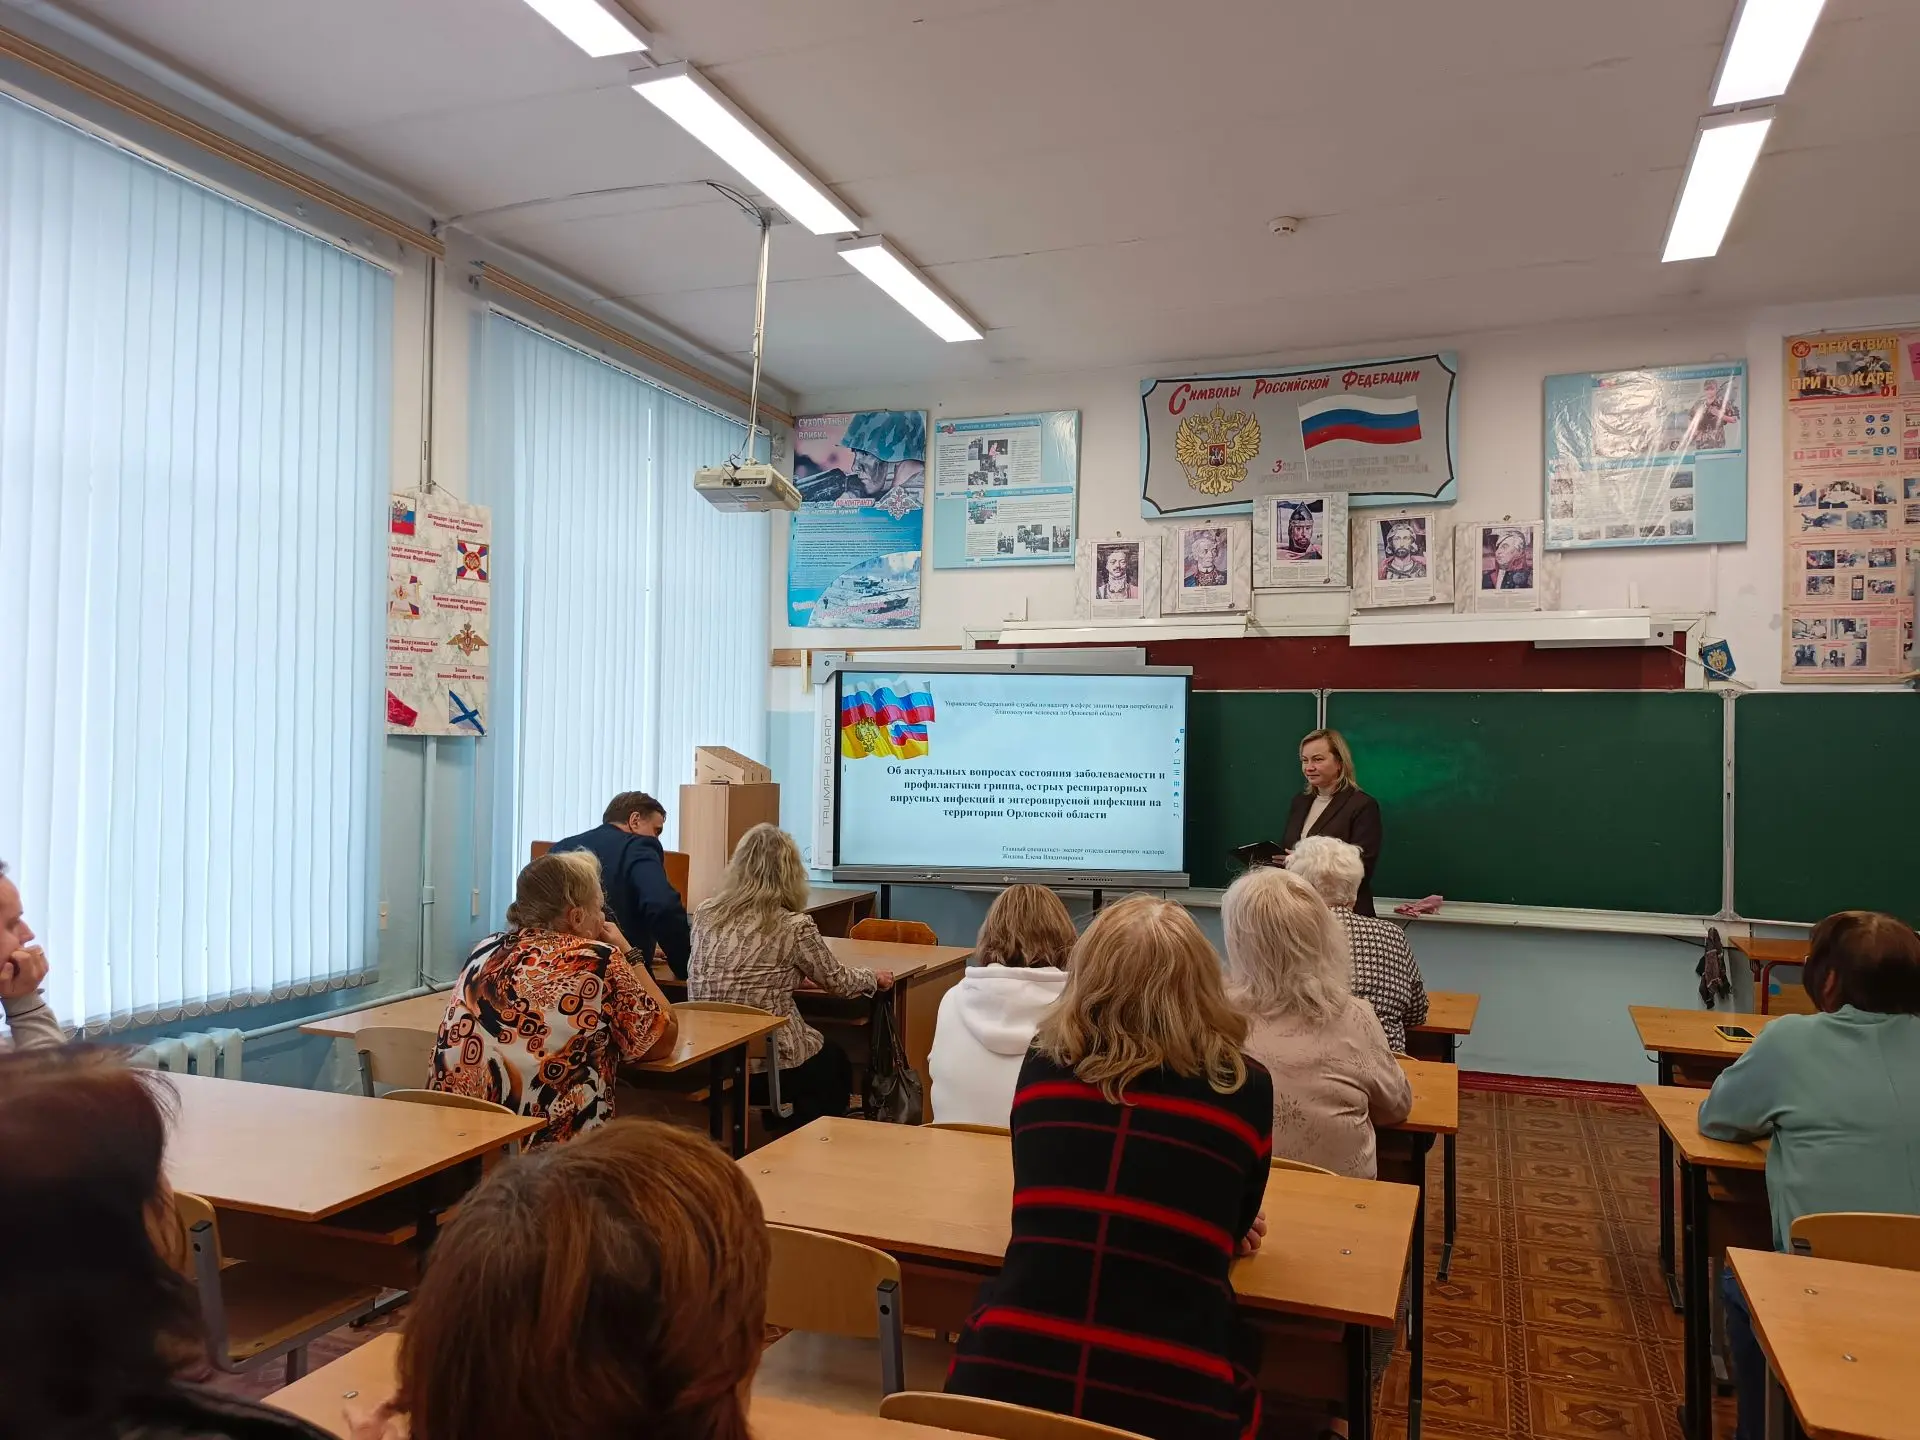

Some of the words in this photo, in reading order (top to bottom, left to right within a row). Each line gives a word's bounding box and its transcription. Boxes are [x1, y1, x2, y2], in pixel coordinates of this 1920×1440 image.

[1818, 336, 1897, 355] ДЕЙСТВИЯ
[1791, 376, 1822, 391] ПРИ
[1827, 371, 1895, 388] ПОЖАРЕ
[1880, 385, 1898, 398] 01
[887, 765, 902, 774] Об
[904, 768, 966, 778] актуальных
[969, 769, 1017, 779] вопросах
[1019, 769, 1072, 777] состояния
[1074, 769, 1156, 779] заболеваемости
[904, 780, 981, 791] профилактики
[983, 781, 1024, 792] гриппа,
[1026, 784, 1064, 794] острых
[1066, 784, 1148, 795] респираторных
[823, 768, 831, 827] TRIUMPH
[890, 794, 940, 805] вирусных
[943, 794, 996, 806] инфекций
[1007, 797, 1090, 807] энтеровирусной
[1093, 797, 1146, 808] инфекции
[943, 809, 1004, 819] территории
[1006, 808, 1063, 820] Орловской
[1066, 809, 1107, 819] области
